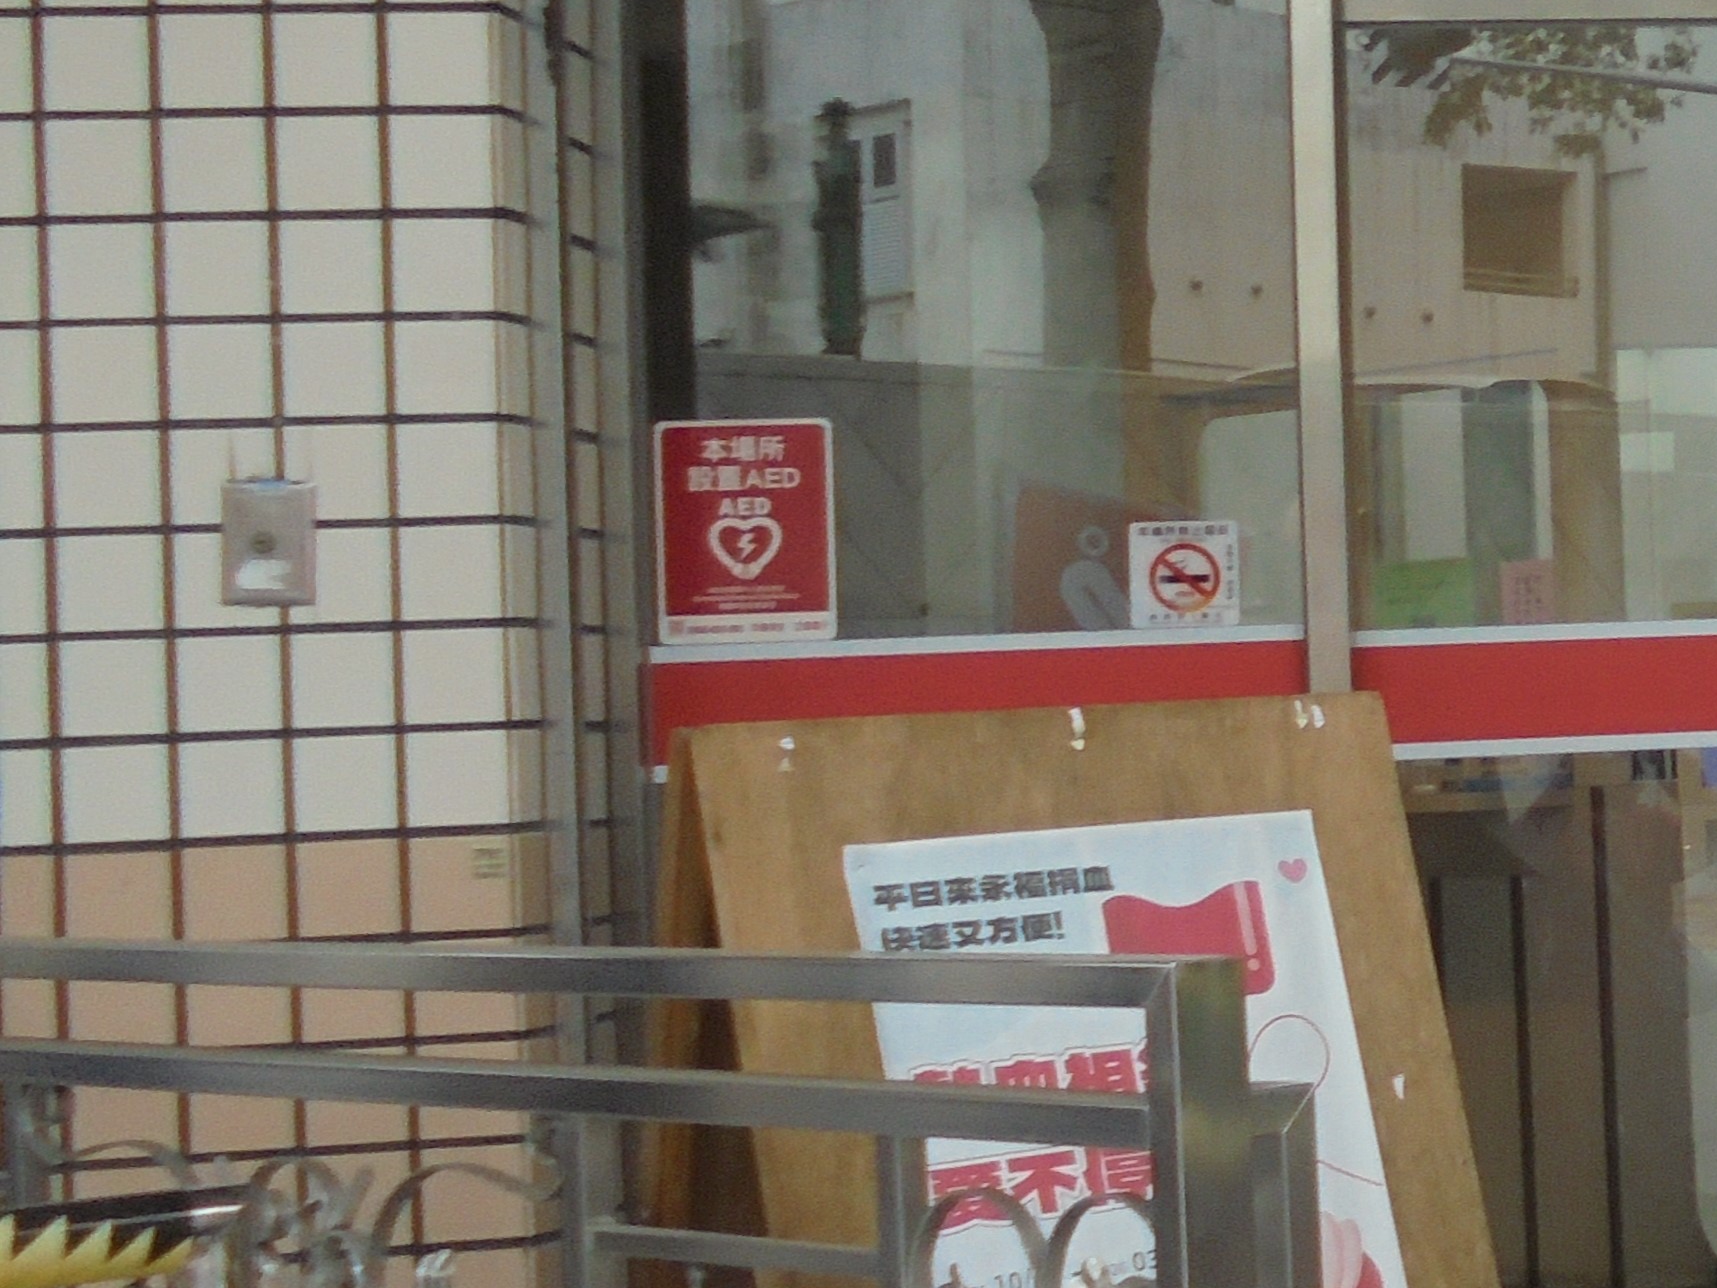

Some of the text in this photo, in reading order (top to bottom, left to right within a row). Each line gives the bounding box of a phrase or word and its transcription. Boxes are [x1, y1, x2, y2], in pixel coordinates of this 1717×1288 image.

[700, 435, 786, 462] 本場所
[686, 466, 801, 492] 設置AED
[718, 497, 772, 516] AED
[872, 864, 1116, 912] 平日來永福捐血
